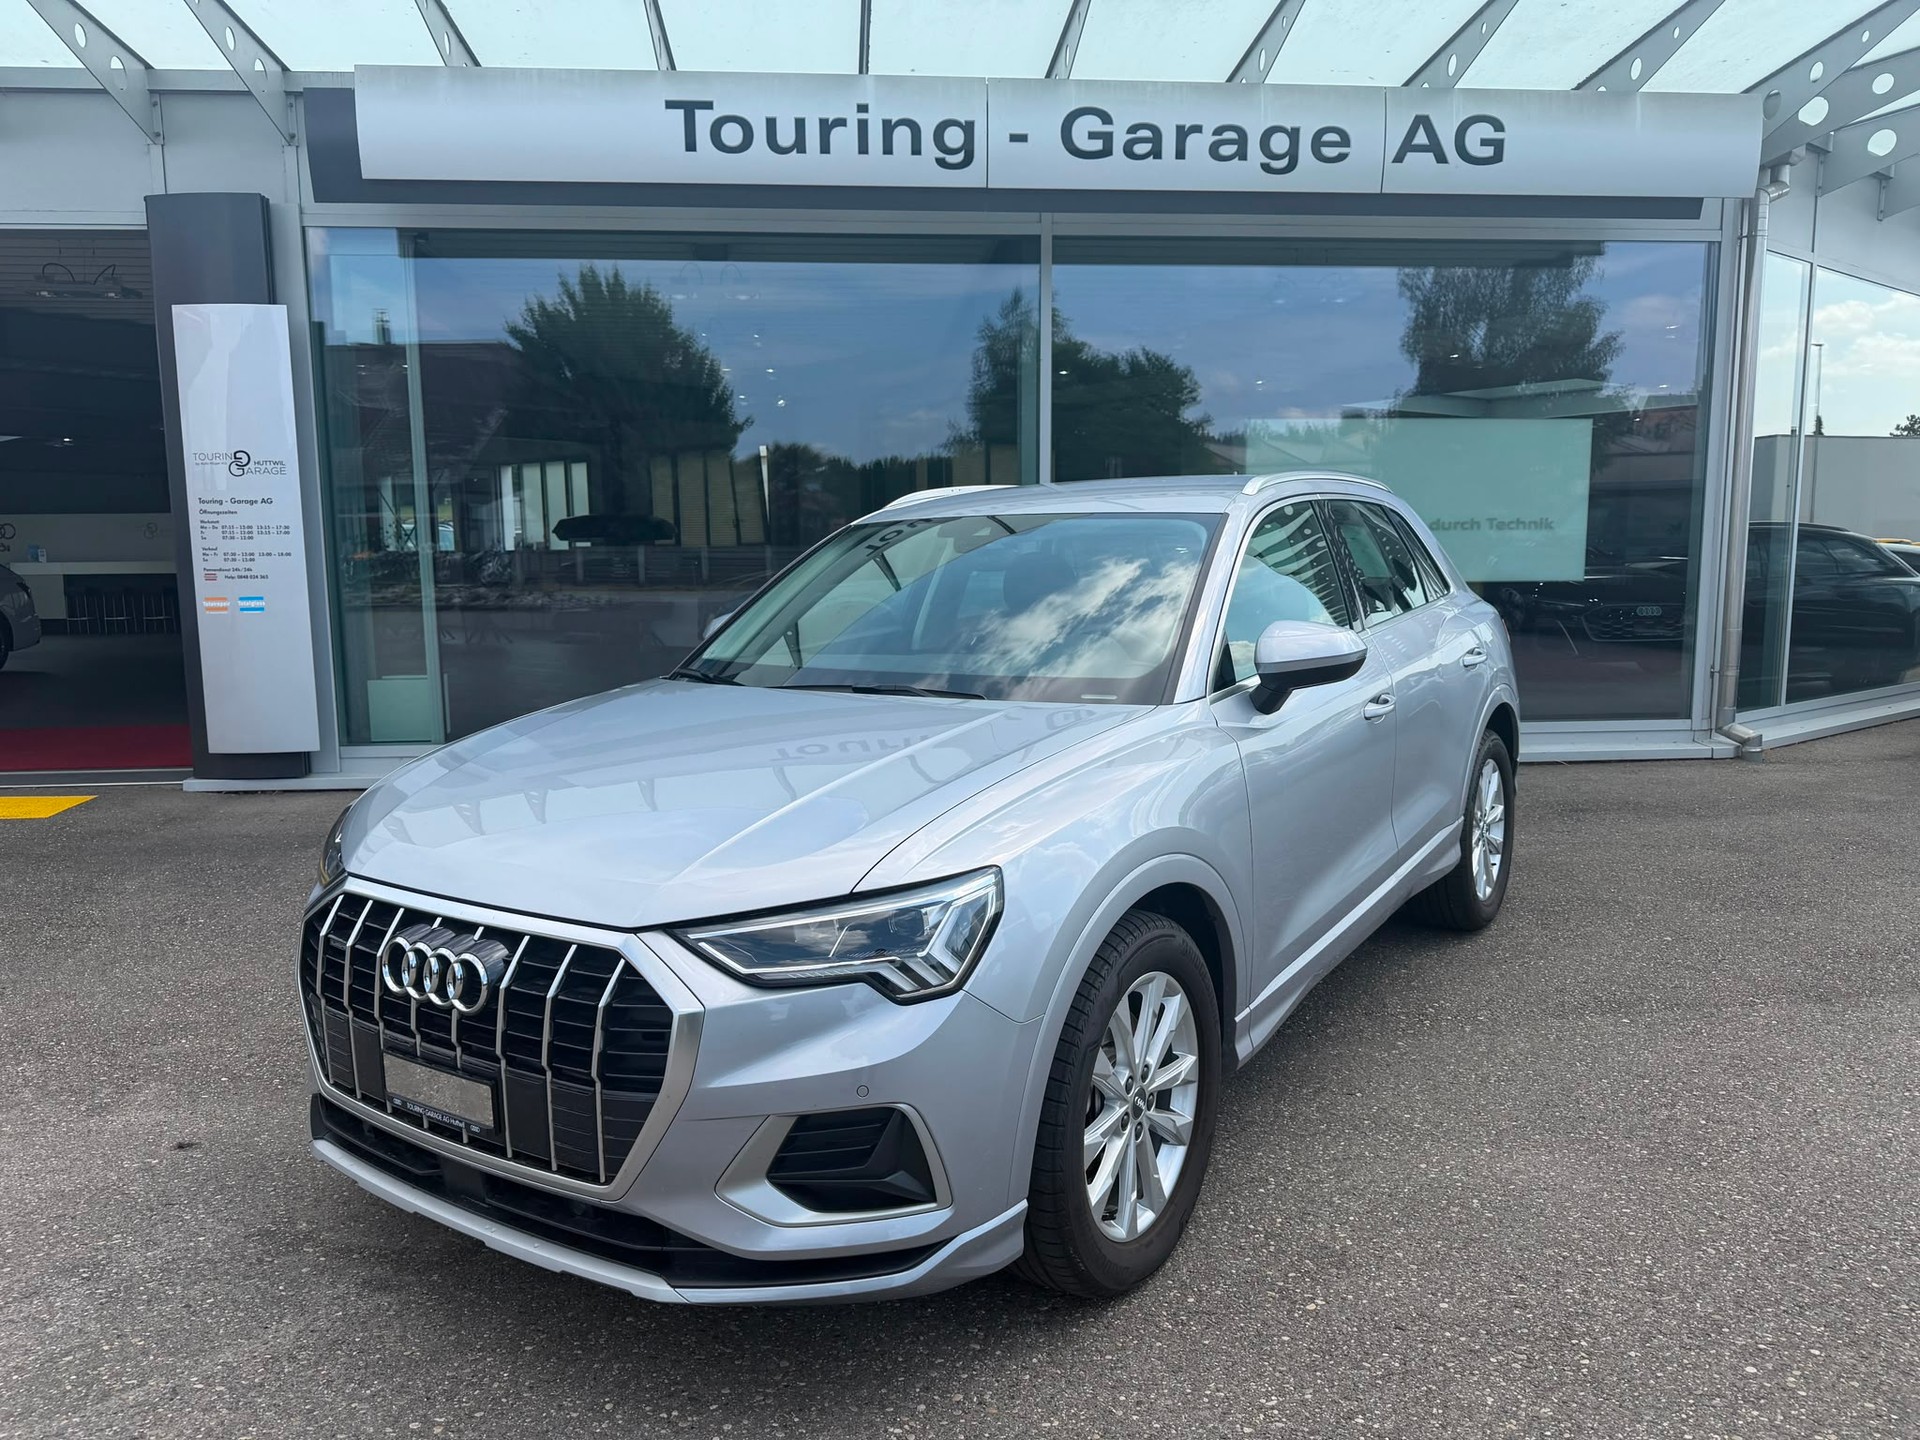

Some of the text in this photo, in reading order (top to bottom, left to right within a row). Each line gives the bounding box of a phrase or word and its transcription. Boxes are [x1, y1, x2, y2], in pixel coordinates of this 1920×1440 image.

[664, 99, 1506, 175] Touring - Garage AG
[198, 497, 223, 506] Touring
[230, 497, 258, 506] Garage
[260, 497, 273, 505] AG
[1429, 517, 1555, 531] durch Technik
